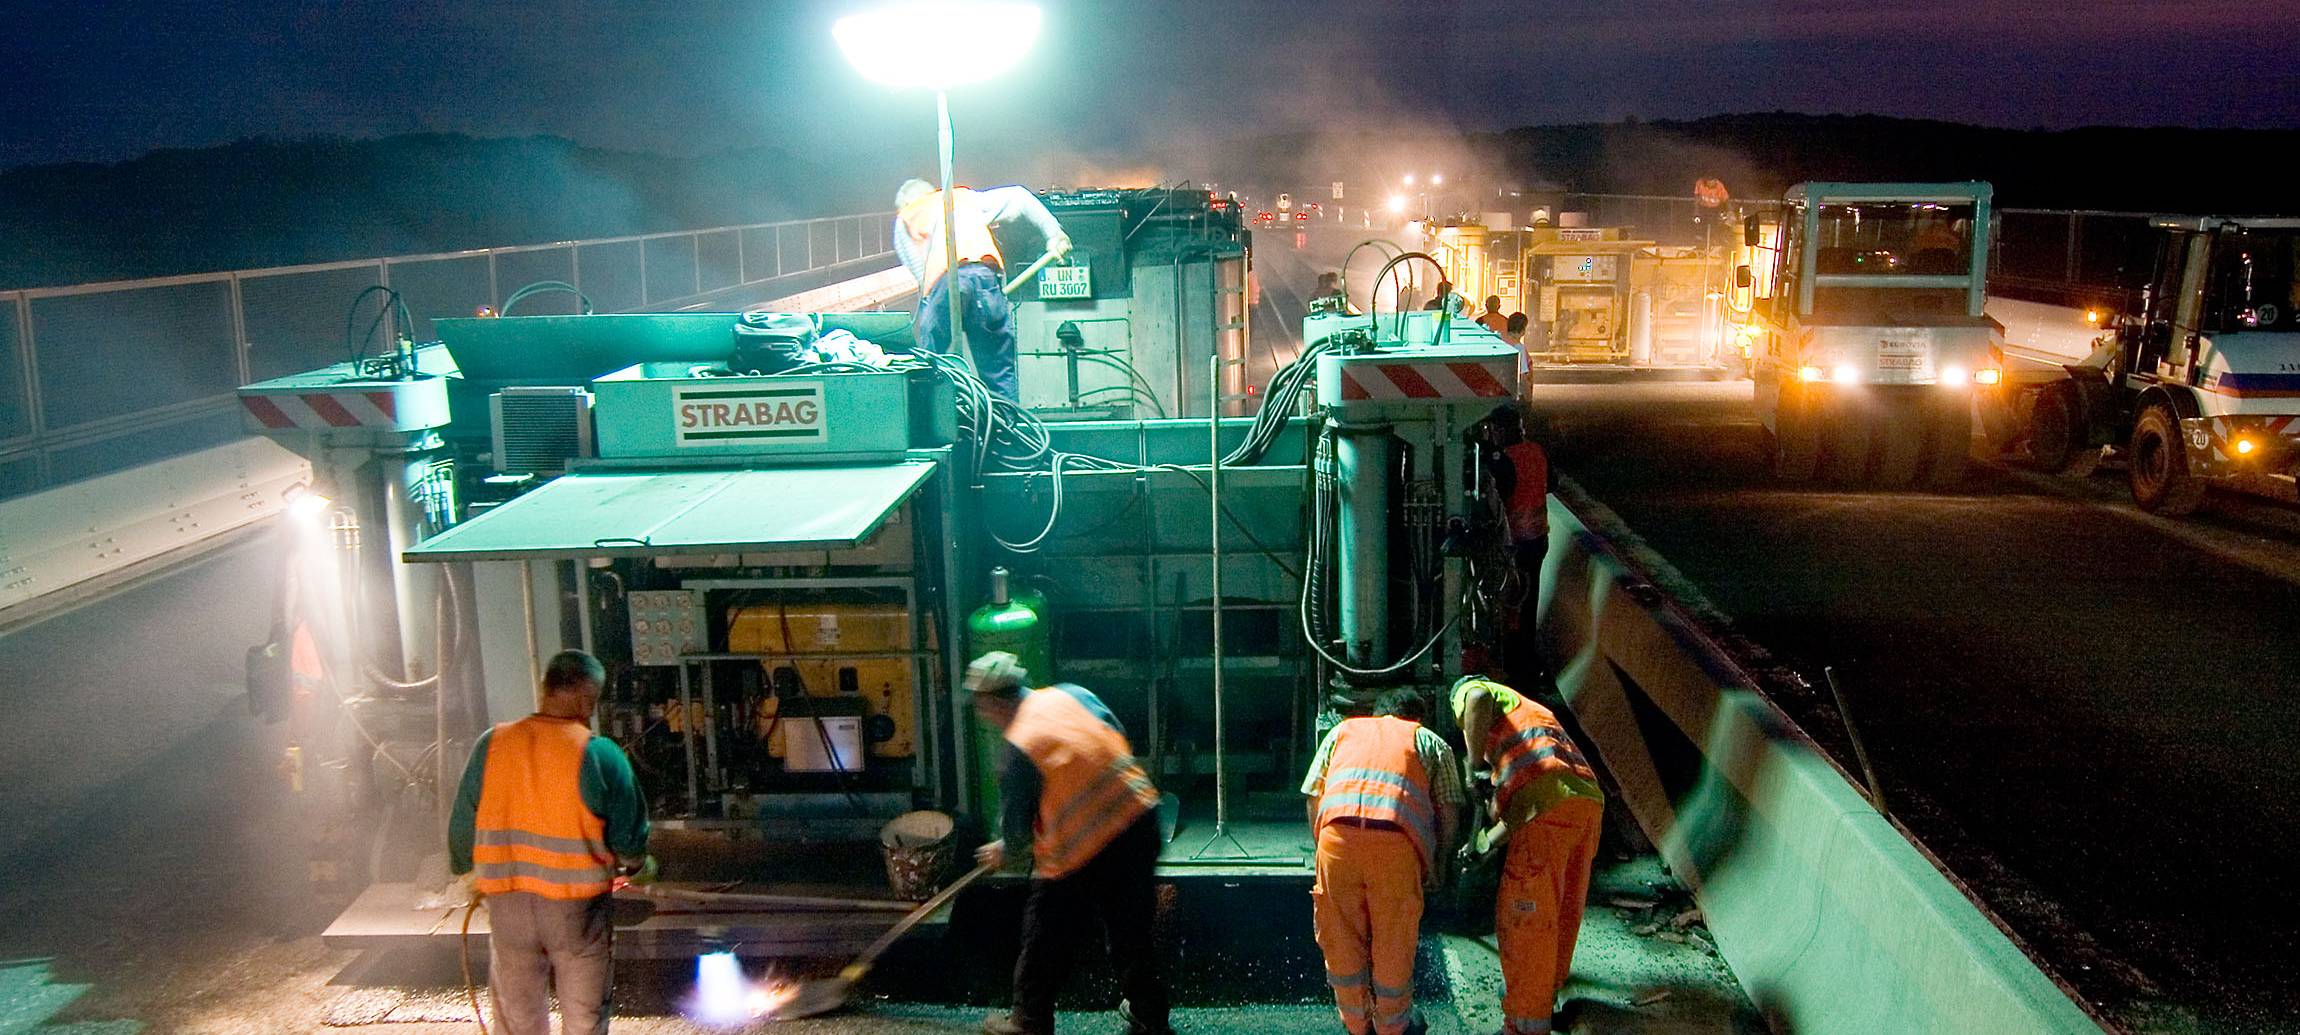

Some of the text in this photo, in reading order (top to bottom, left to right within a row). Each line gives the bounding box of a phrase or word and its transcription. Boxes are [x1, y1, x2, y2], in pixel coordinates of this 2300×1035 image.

[1057, 269, 1073, 282] UN
[1042, 282, 1087, 296] RU 3007
[2260, 307, 2274, 321] 20
[681, 400, 818, 428] STRABAG
